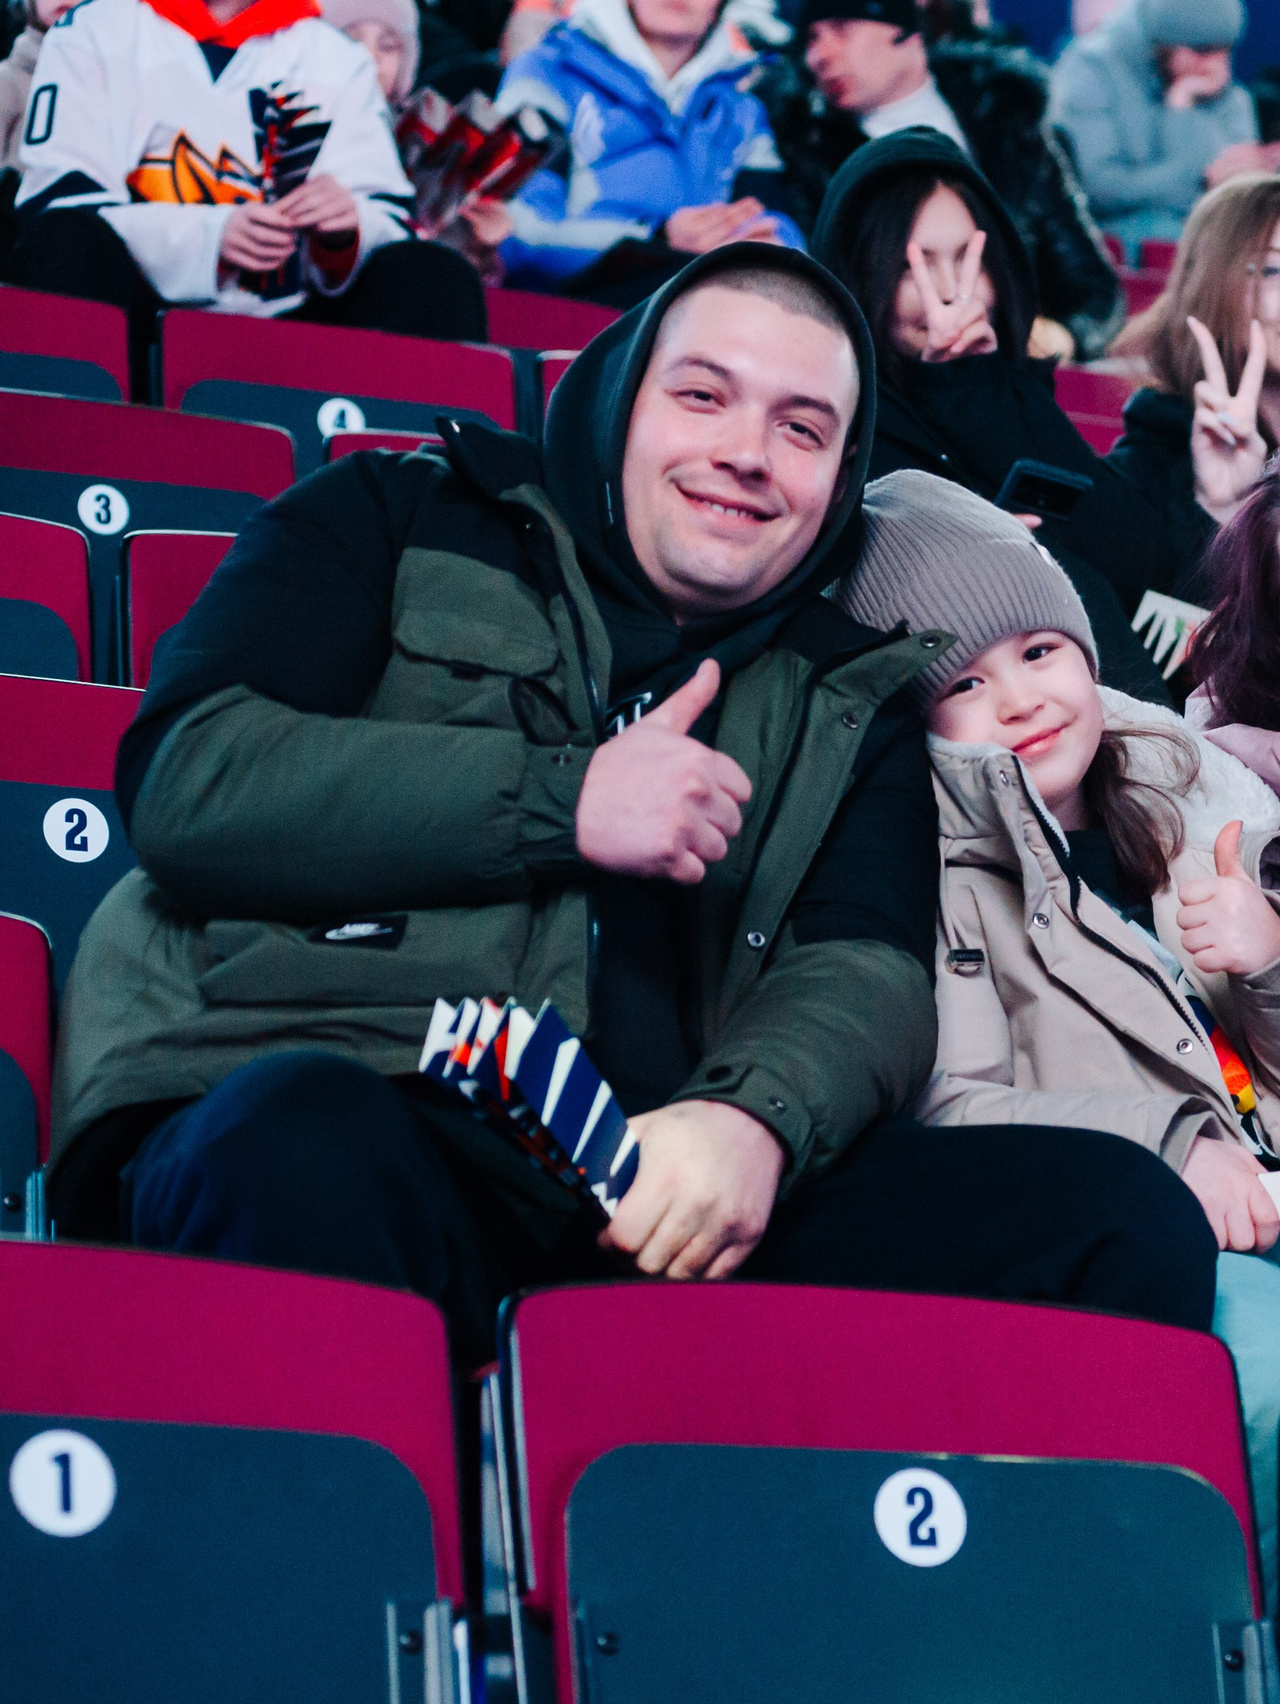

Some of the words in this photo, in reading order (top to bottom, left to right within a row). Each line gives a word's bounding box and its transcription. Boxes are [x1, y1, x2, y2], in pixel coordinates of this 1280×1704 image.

[95, 493, 111, 525] 3
[64, 807, 89, 852] 2
[53, 1453, 71, 1513] 1
[907, 1487, 937, 1547] 2
